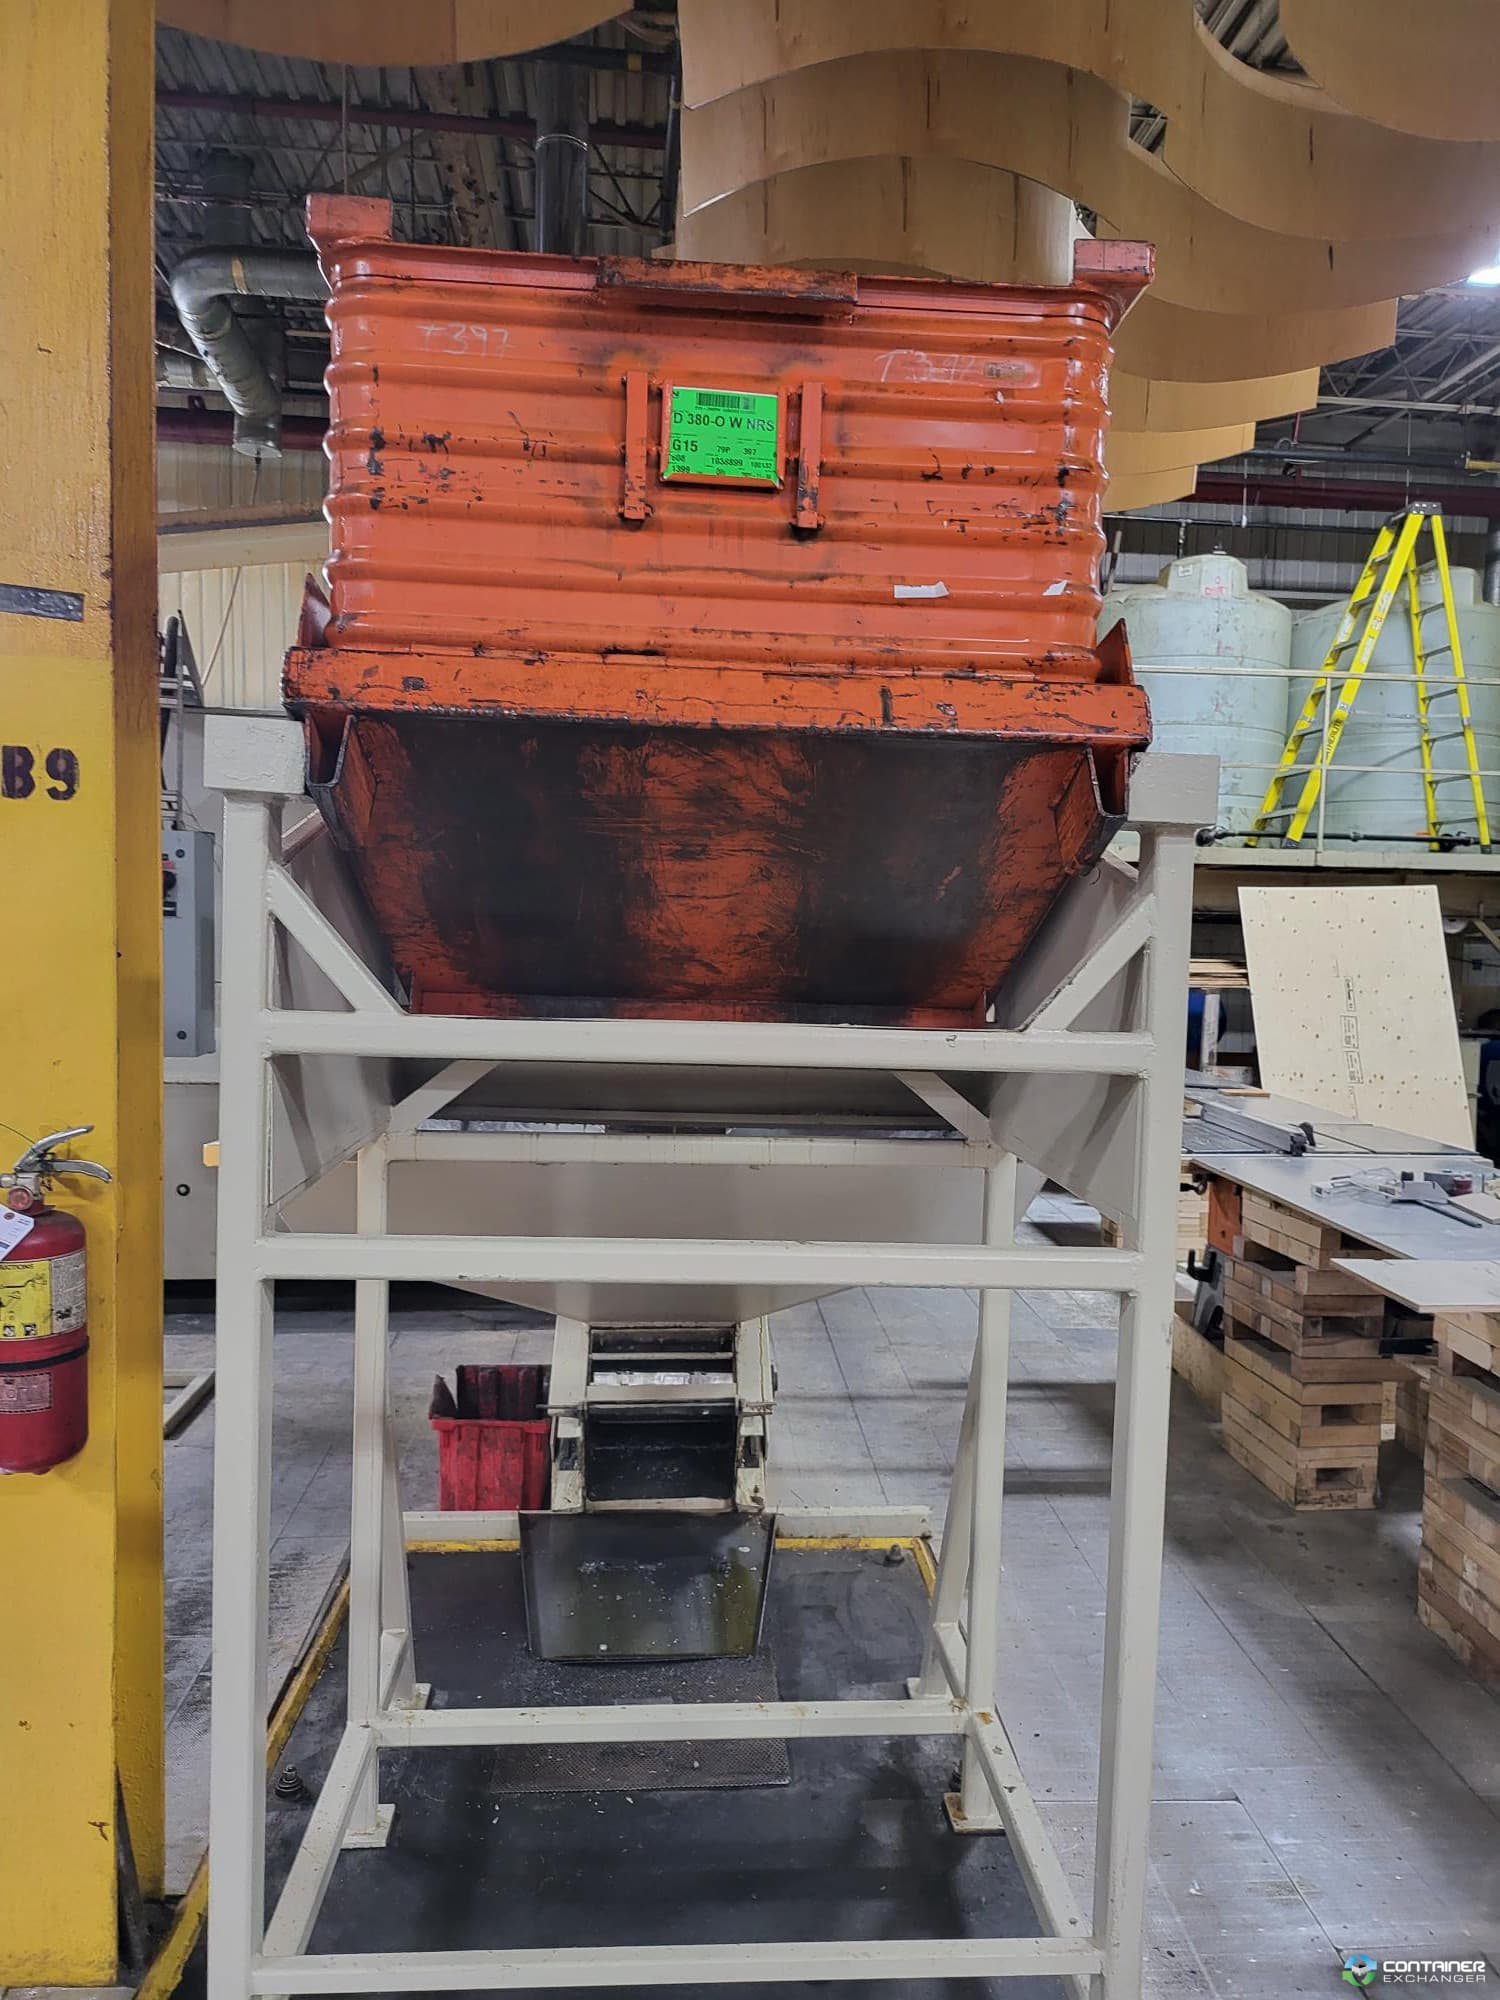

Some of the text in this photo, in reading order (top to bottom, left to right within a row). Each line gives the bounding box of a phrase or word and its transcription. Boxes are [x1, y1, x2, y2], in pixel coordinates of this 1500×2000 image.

[673, 412, 683, 424] D
[730, 417, 742, 429] W
[747, 419, 775, 432] NRS
[672, 439, 698, 452] G15
[2, 745, 80, 801] B9
